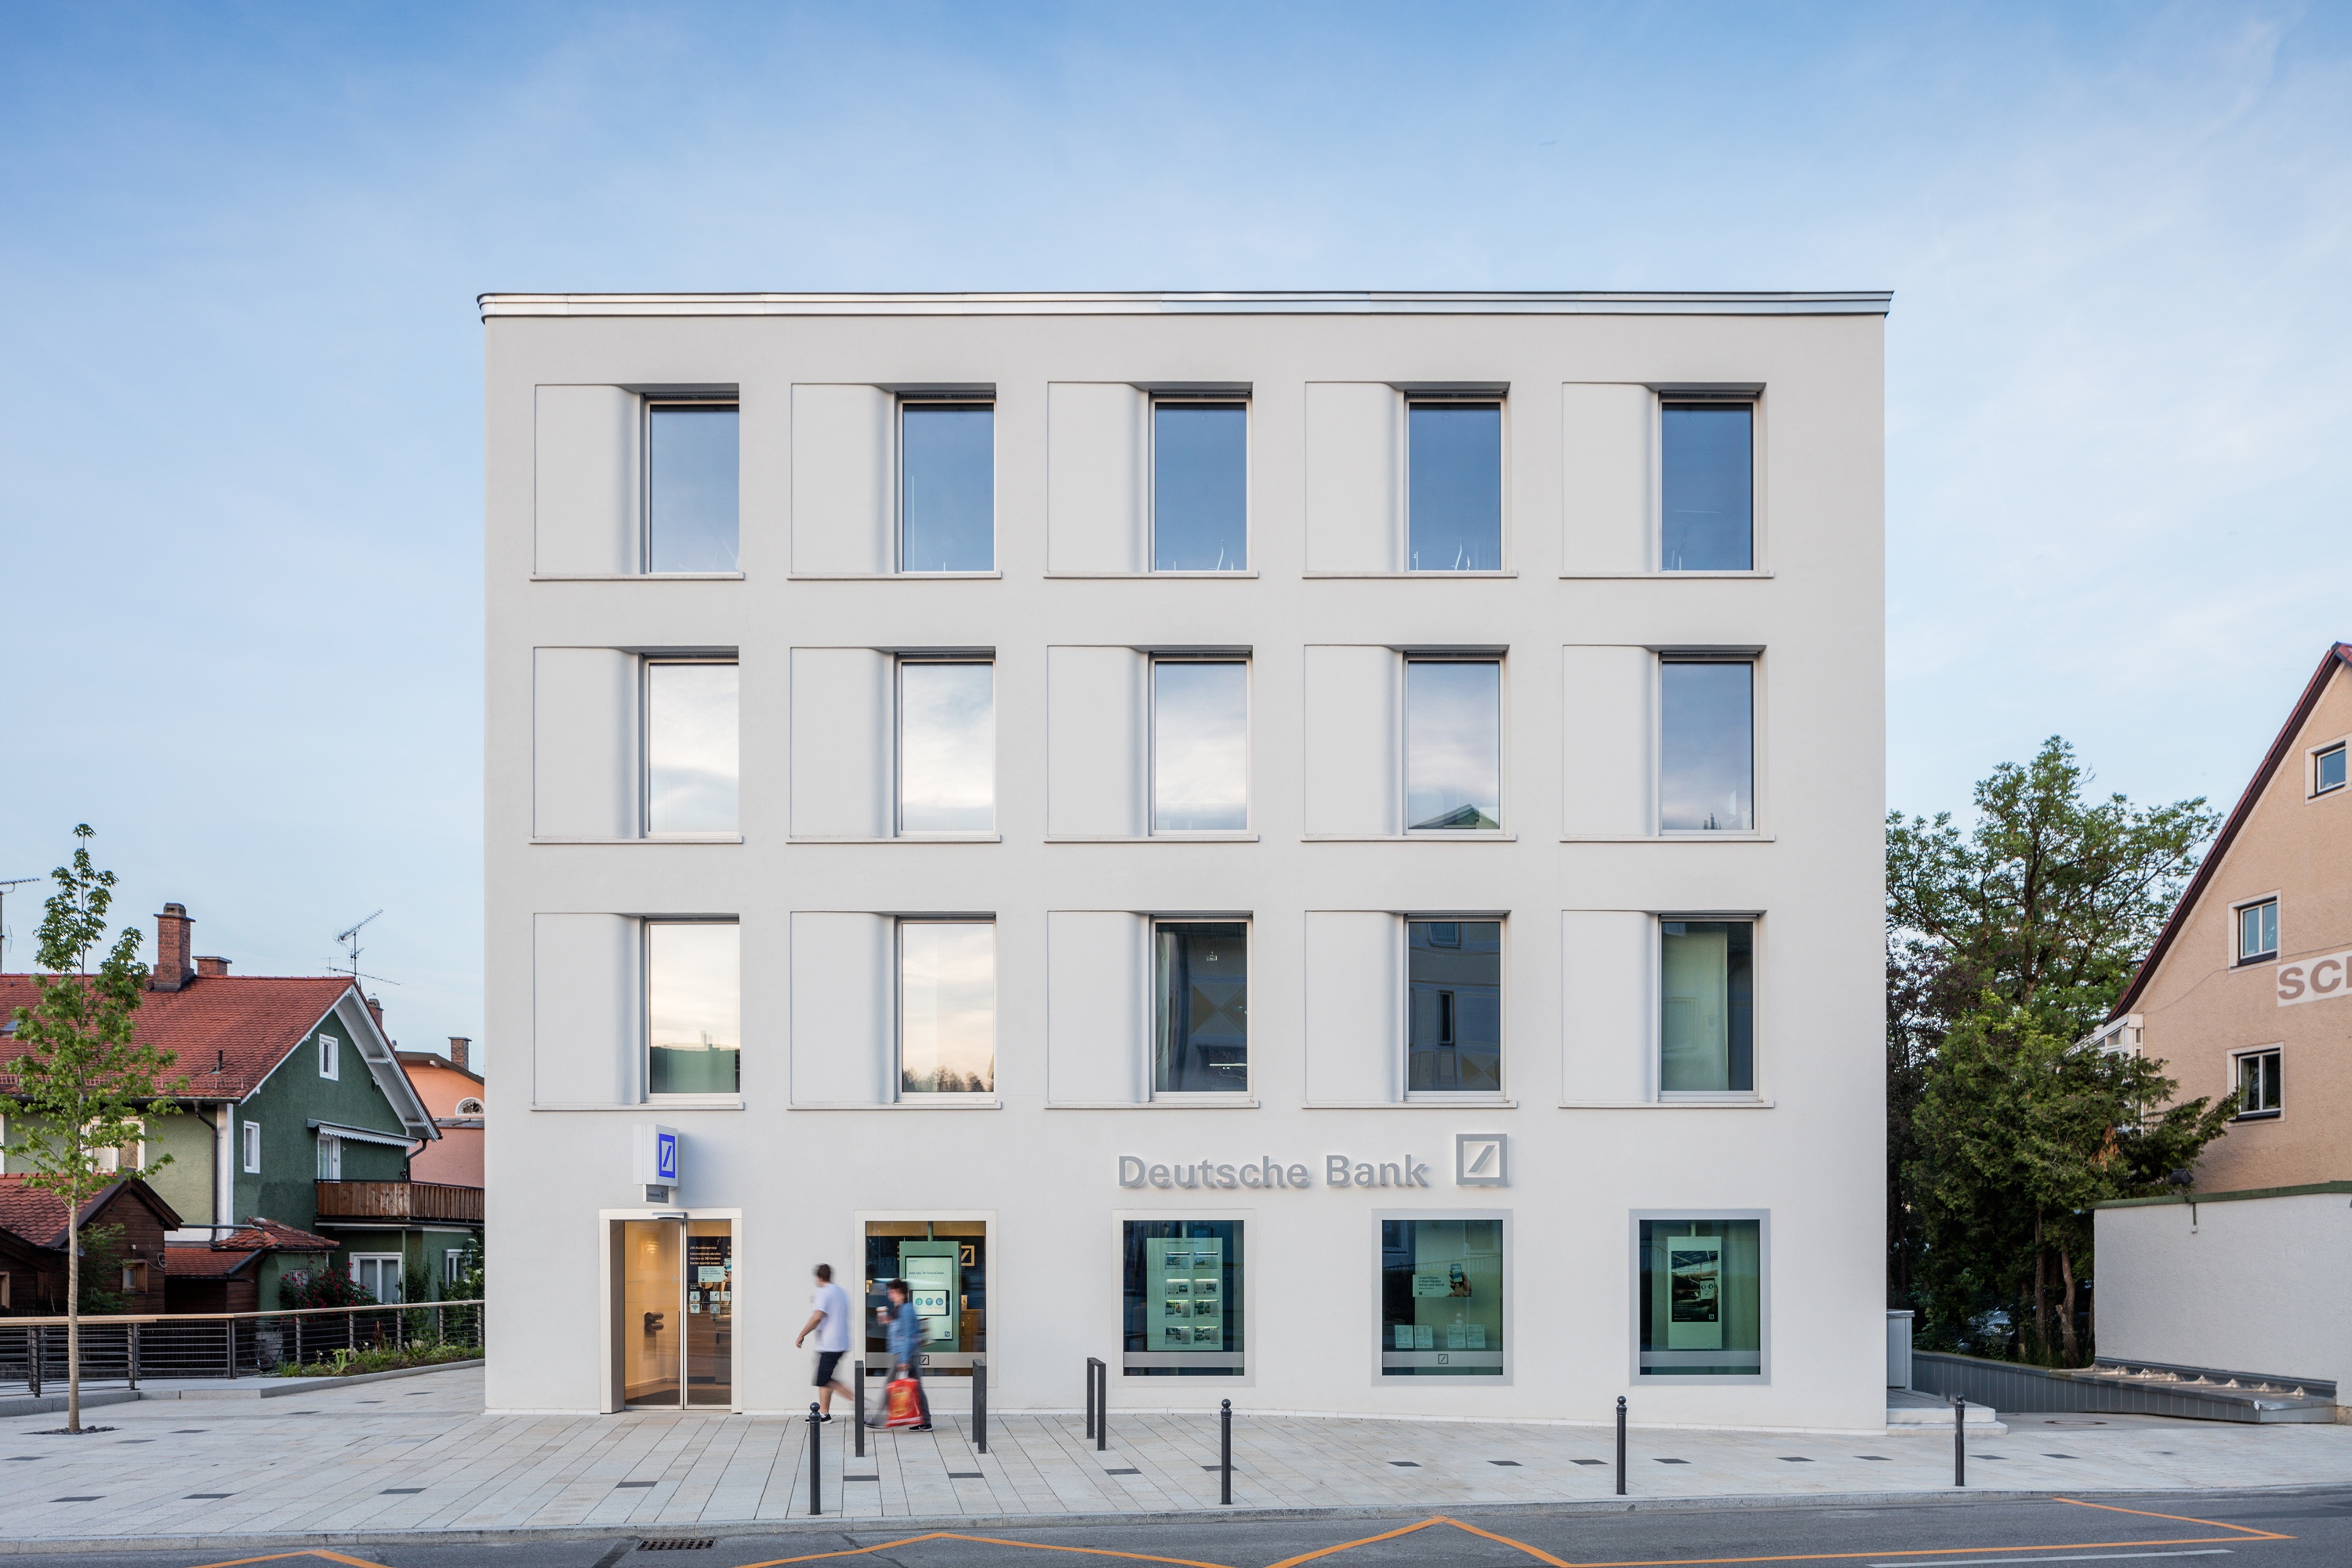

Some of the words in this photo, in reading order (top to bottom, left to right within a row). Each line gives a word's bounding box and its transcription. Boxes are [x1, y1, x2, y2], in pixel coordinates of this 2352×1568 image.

[2278, 956, 2352, 1000] SC
[1119, 1156, 1308, 1187] Deutsche
[1326, 1154, 1428, 1186] Bank
